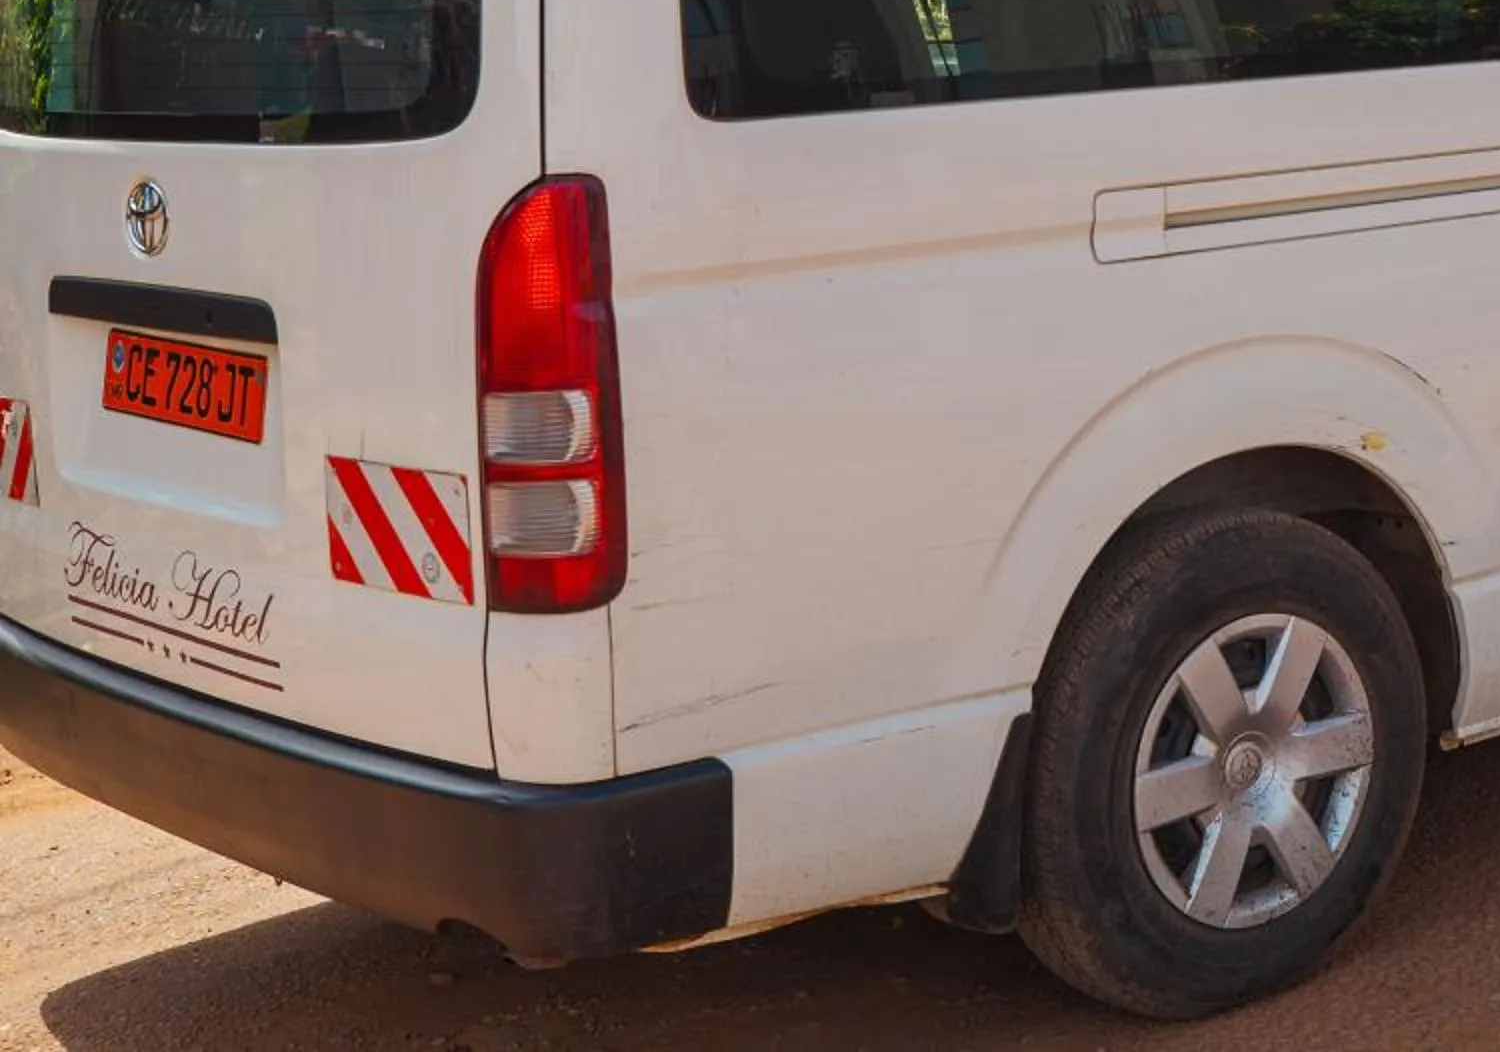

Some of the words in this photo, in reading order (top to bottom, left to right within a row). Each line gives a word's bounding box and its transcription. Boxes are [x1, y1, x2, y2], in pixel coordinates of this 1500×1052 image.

[127, 343, 160, 407] CE
[166, 351, 214, 418] 728
[217, 362, 256, 427] JT
[64, 521, 159, 611] Felicia
[168, 550, 274, 645] Hotel
